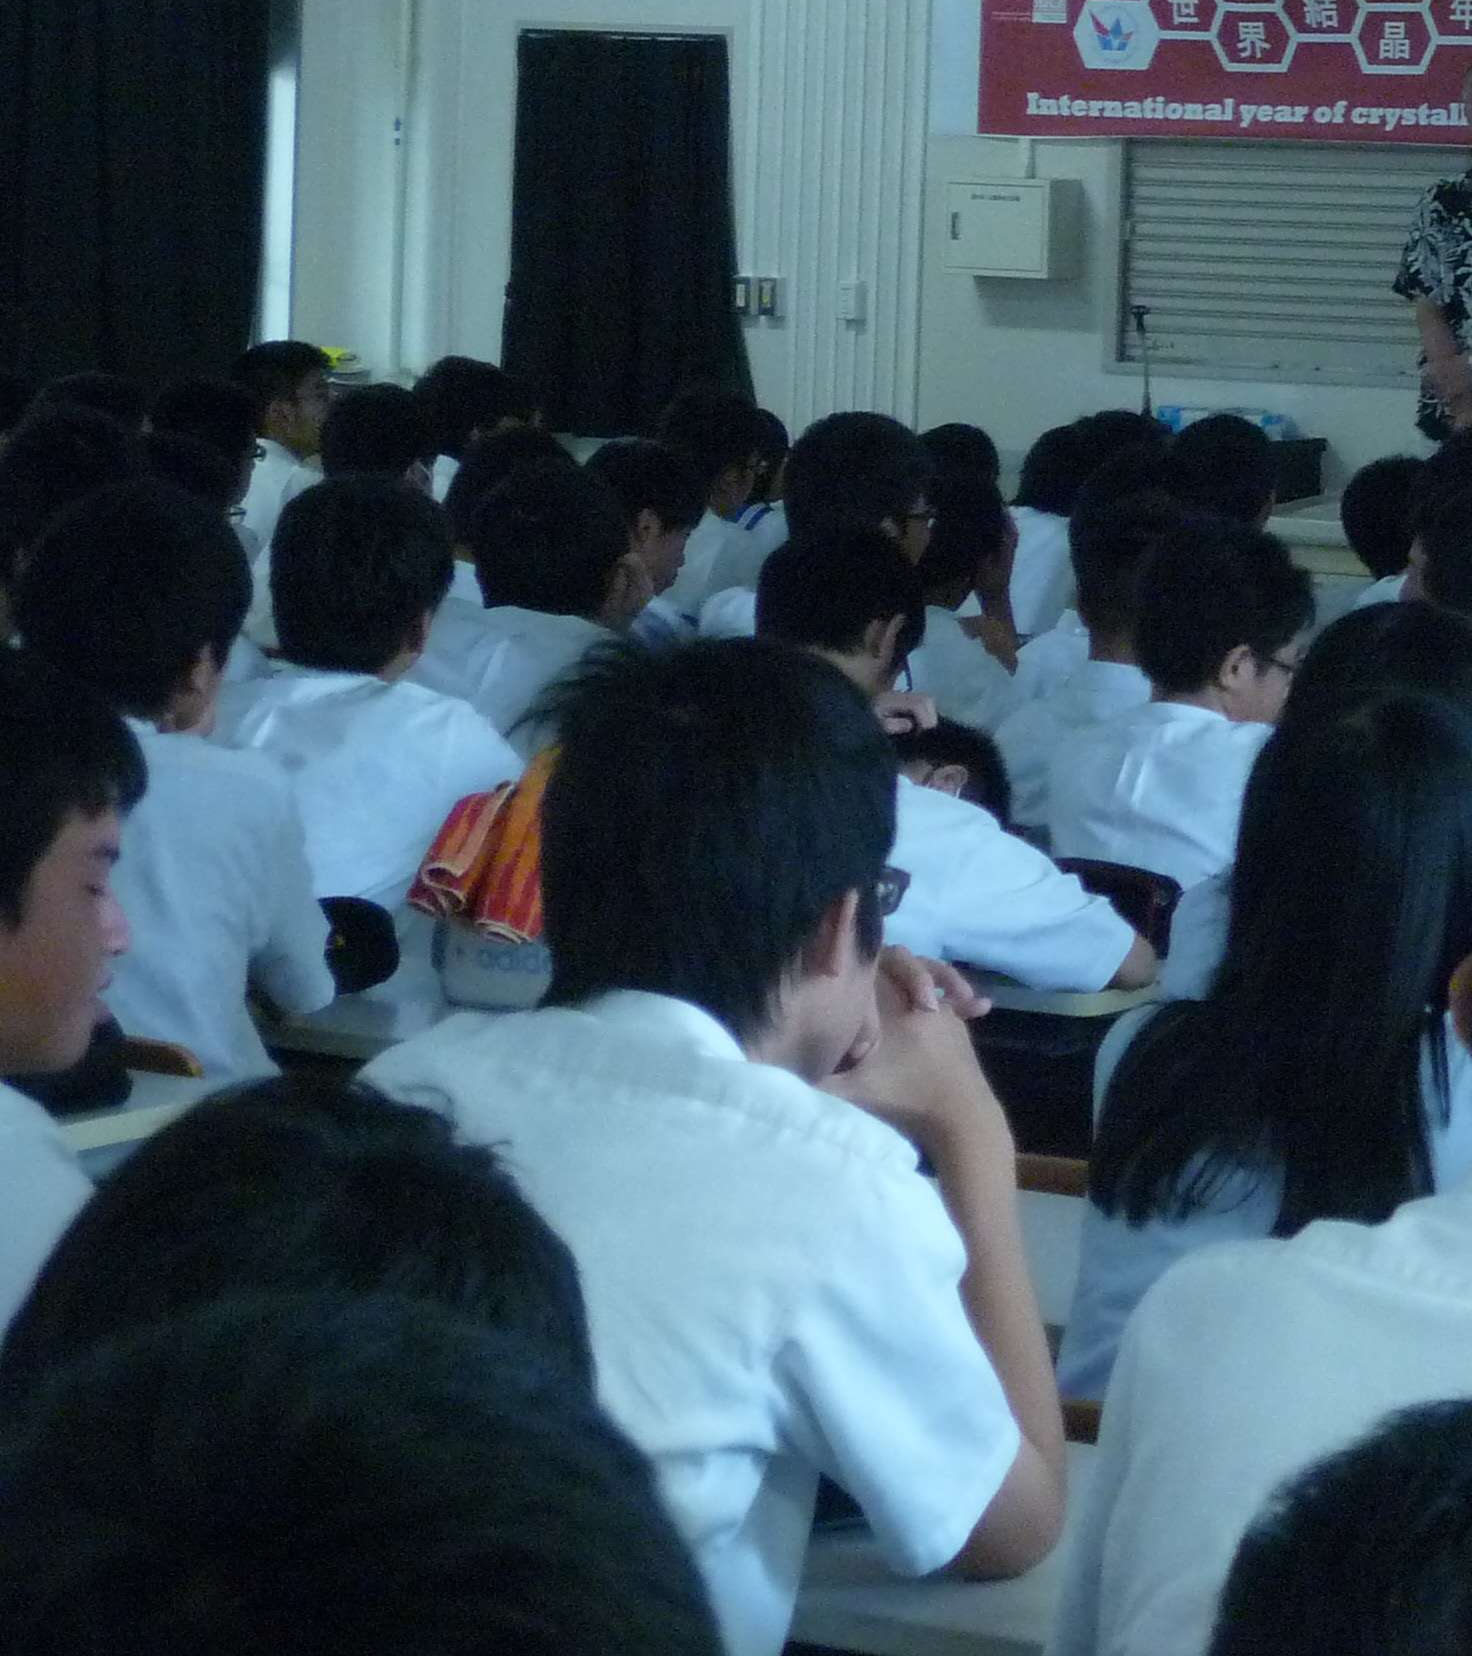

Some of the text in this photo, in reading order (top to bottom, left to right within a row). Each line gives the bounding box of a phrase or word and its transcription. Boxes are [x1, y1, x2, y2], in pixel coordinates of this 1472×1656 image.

[1026, 91, 1235, 121] International
[1239, 100, 1310, 128] year
[1312, 100, 1349, 124] of
